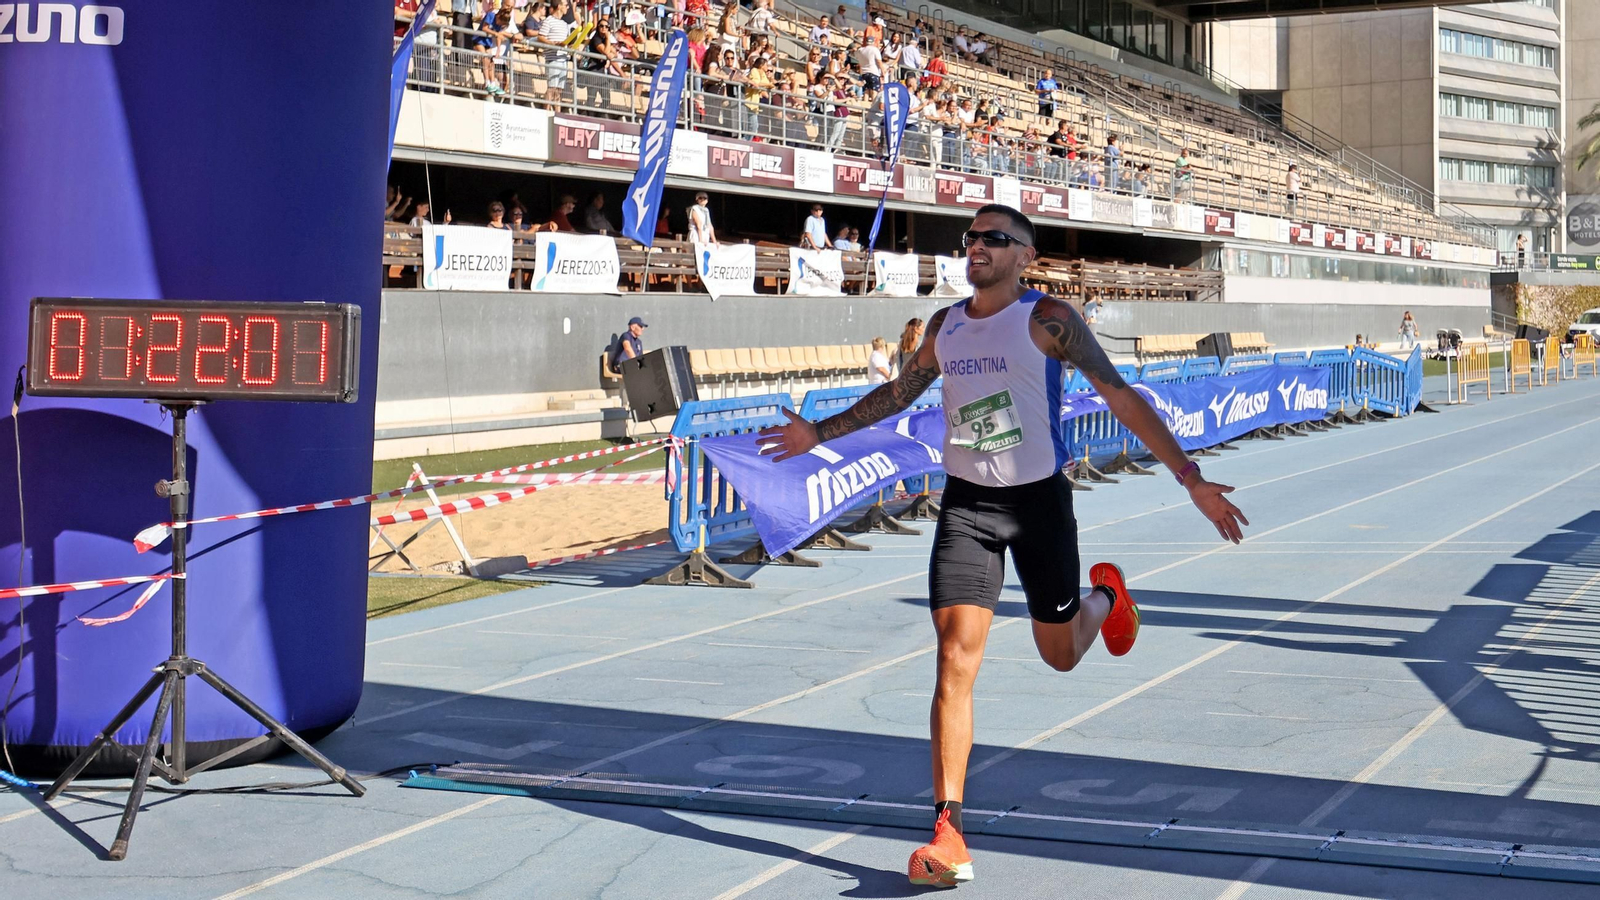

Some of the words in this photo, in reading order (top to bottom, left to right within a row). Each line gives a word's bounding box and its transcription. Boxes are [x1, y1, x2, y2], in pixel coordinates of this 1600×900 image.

[558, 126, 596, 148] PLAY
[588, 126, 641, 161] JEREZ
[712, 147, 748, 167] PLAY
[740, 147, 783, 178] JEREZ
[836, 165, 864, 183] PLAY
[938, 180, 961, 195] PLAY
[956, 178, 986, 203] JEREZ
[444, 254, 508, 272] JEREZ2031
[555, 259, 614, 275] JEREZ2031
[709, 265, 752, 280] JEREZ2031
[49, 312, 328, 385] 01:22:01
[944, 356, 1008, 377] ARGENTINA
[970, 416, 995, 440] 95
